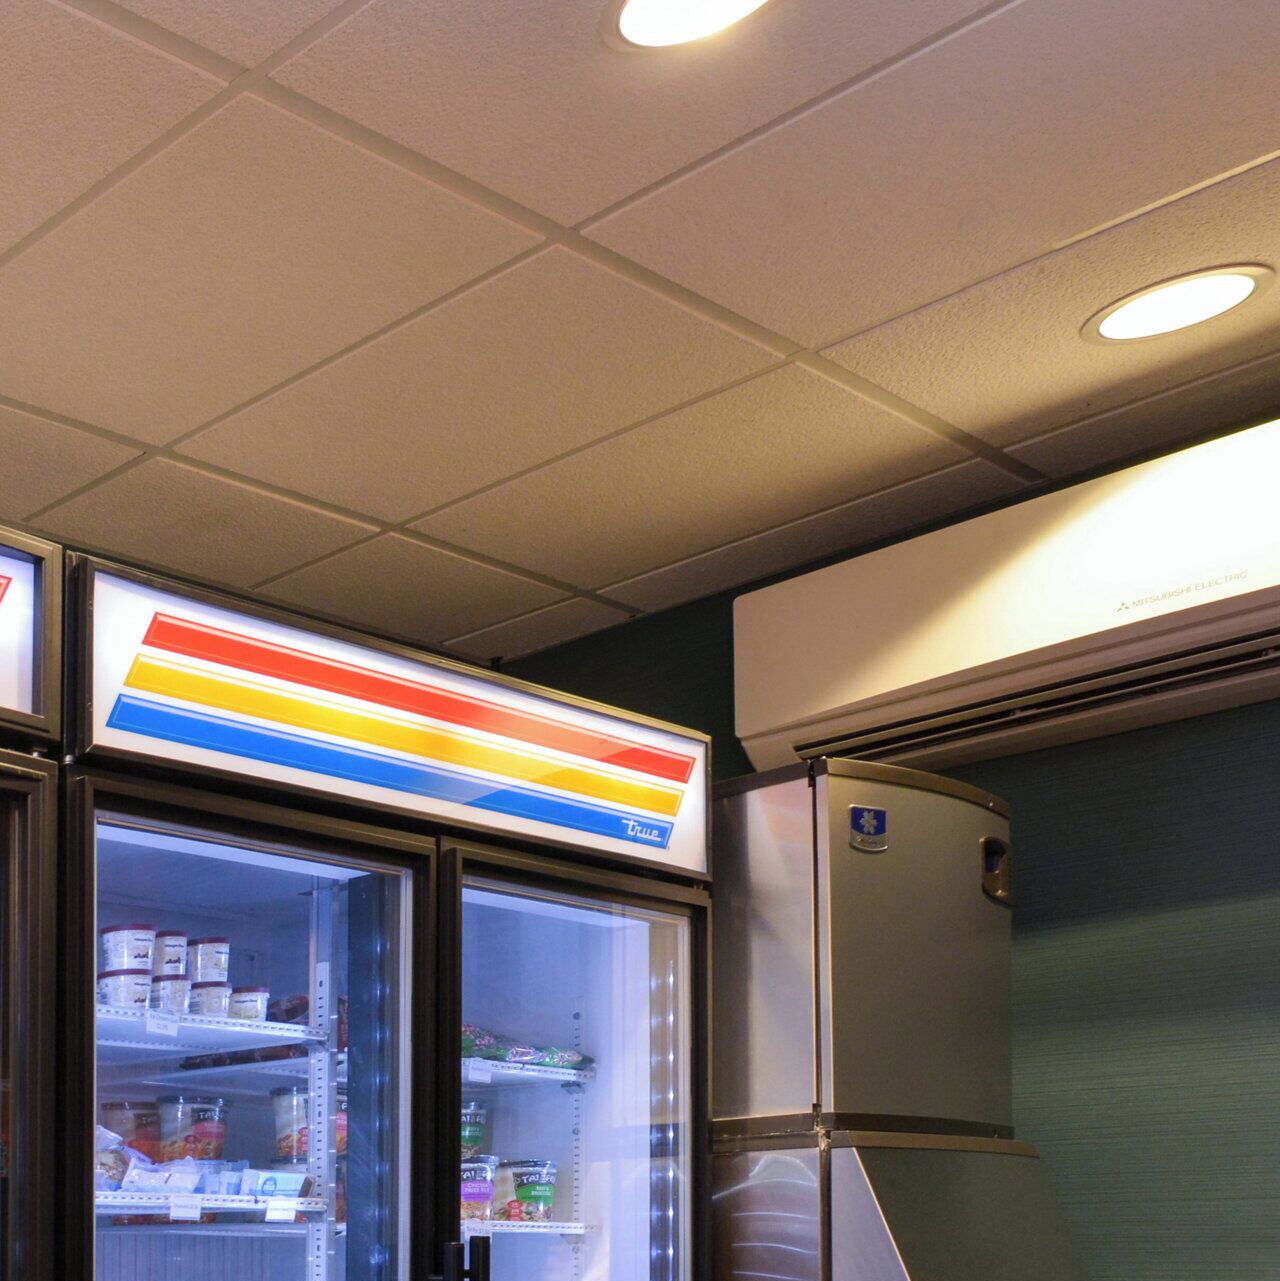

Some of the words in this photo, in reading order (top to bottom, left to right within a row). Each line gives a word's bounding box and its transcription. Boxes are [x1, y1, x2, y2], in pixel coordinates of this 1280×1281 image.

[1130, 585, 1192, 608] MITSUBISHI
[1193, 570, 1249, 592] ELECTRIC
[621, 818, 663, 843] true
